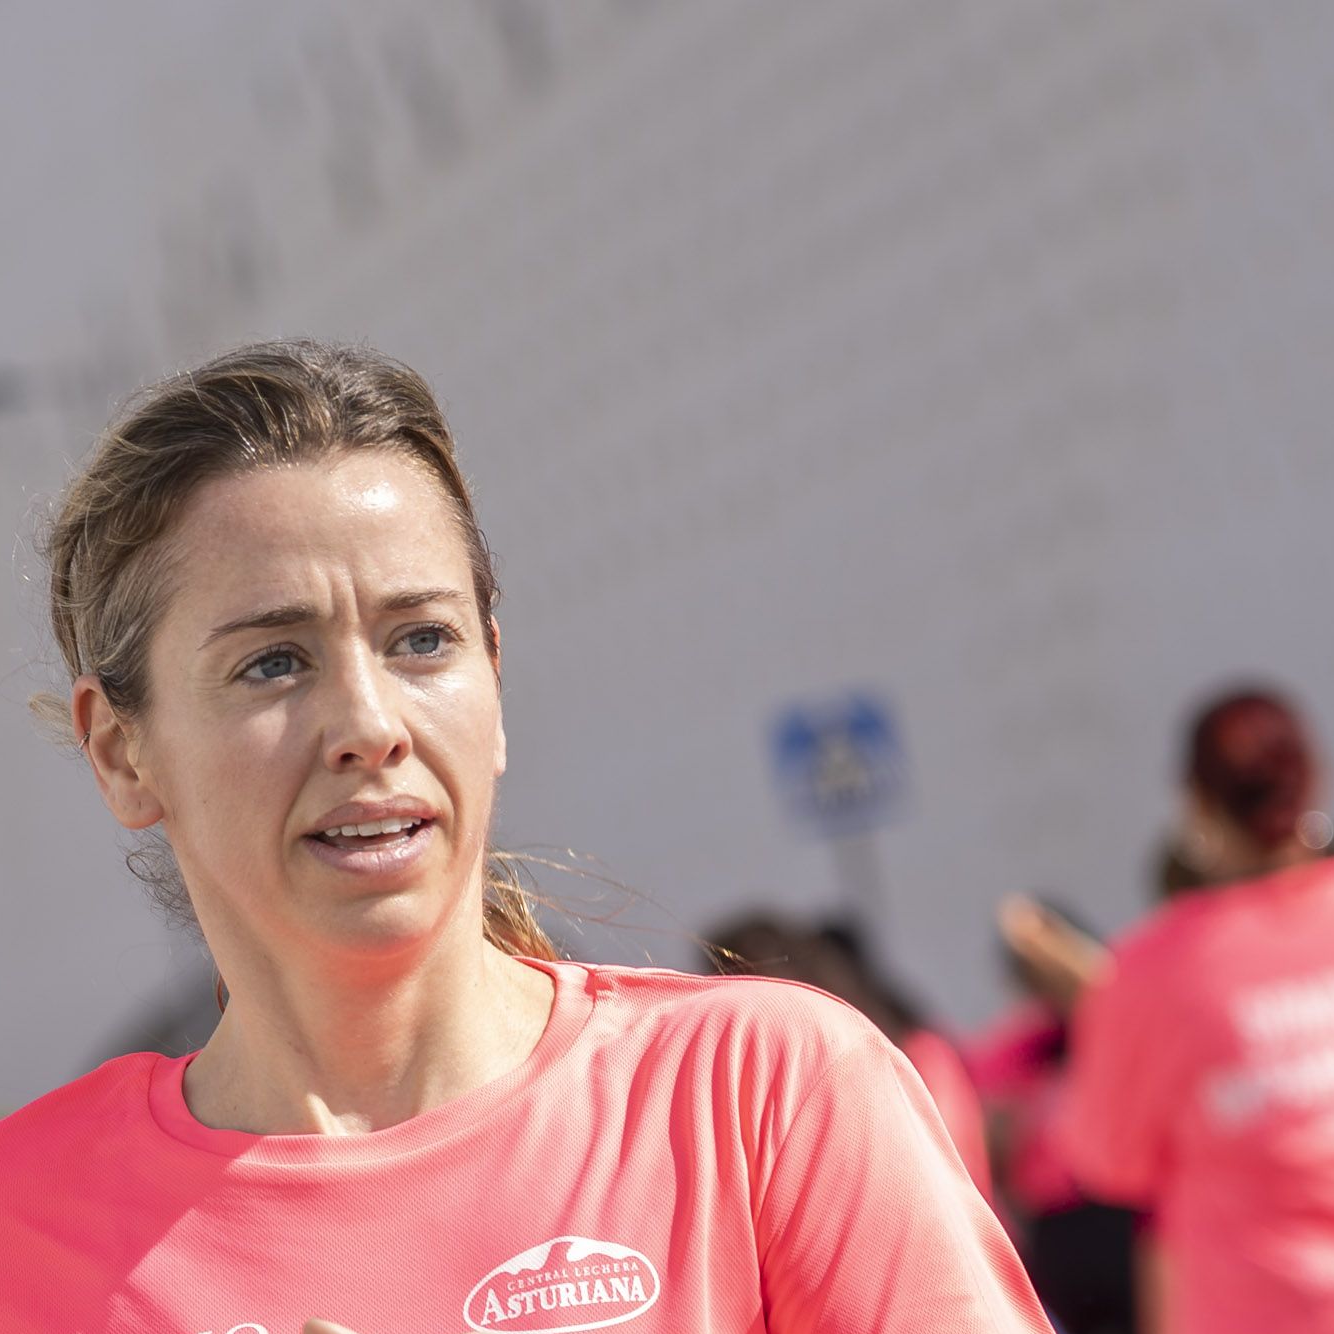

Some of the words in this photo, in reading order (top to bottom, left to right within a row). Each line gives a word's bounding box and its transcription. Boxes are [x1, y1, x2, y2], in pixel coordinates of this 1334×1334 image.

[507, 1270, 568, 1292] CENTRAL
[574, 1261, 640, 1278] LECHERA
[480, 1275, 648, 1326] ASTURIANA
